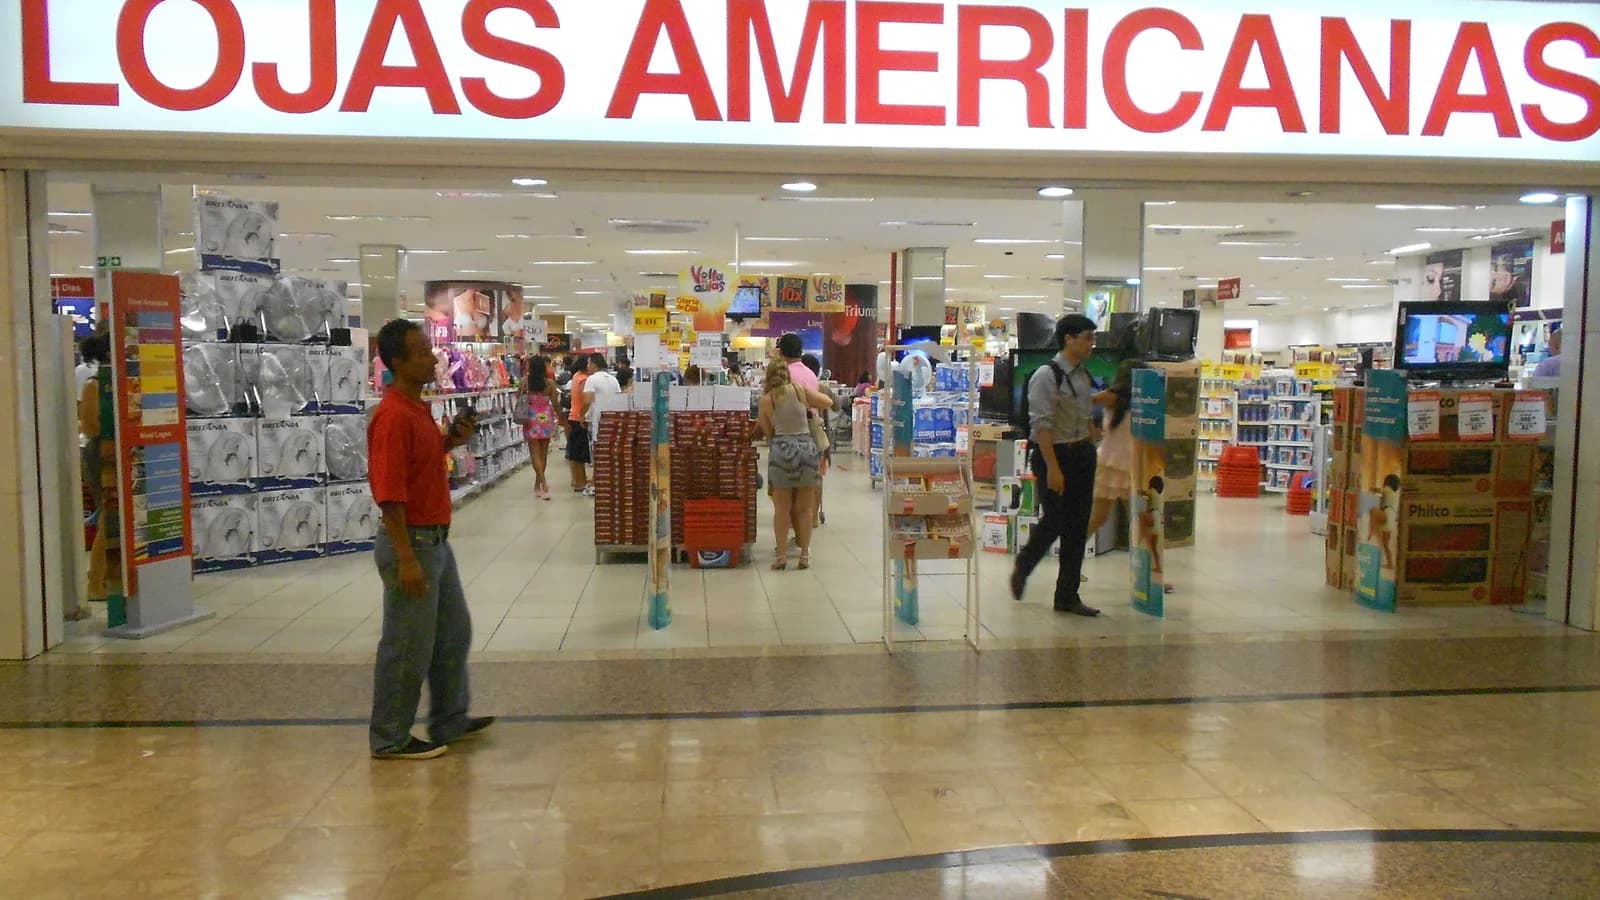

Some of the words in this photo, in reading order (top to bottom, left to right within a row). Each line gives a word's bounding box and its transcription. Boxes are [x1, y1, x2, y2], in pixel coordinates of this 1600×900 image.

[22, 0, 566, 119] LOJAS
[603, 0, 1600, 142] AMERICANAS
[690, 265, 724, 284] Volta
[694, 281, 726, 293] aulas
[813, 276, 842, 294] Volta
[1408, 503, 1449, 518] Philco
